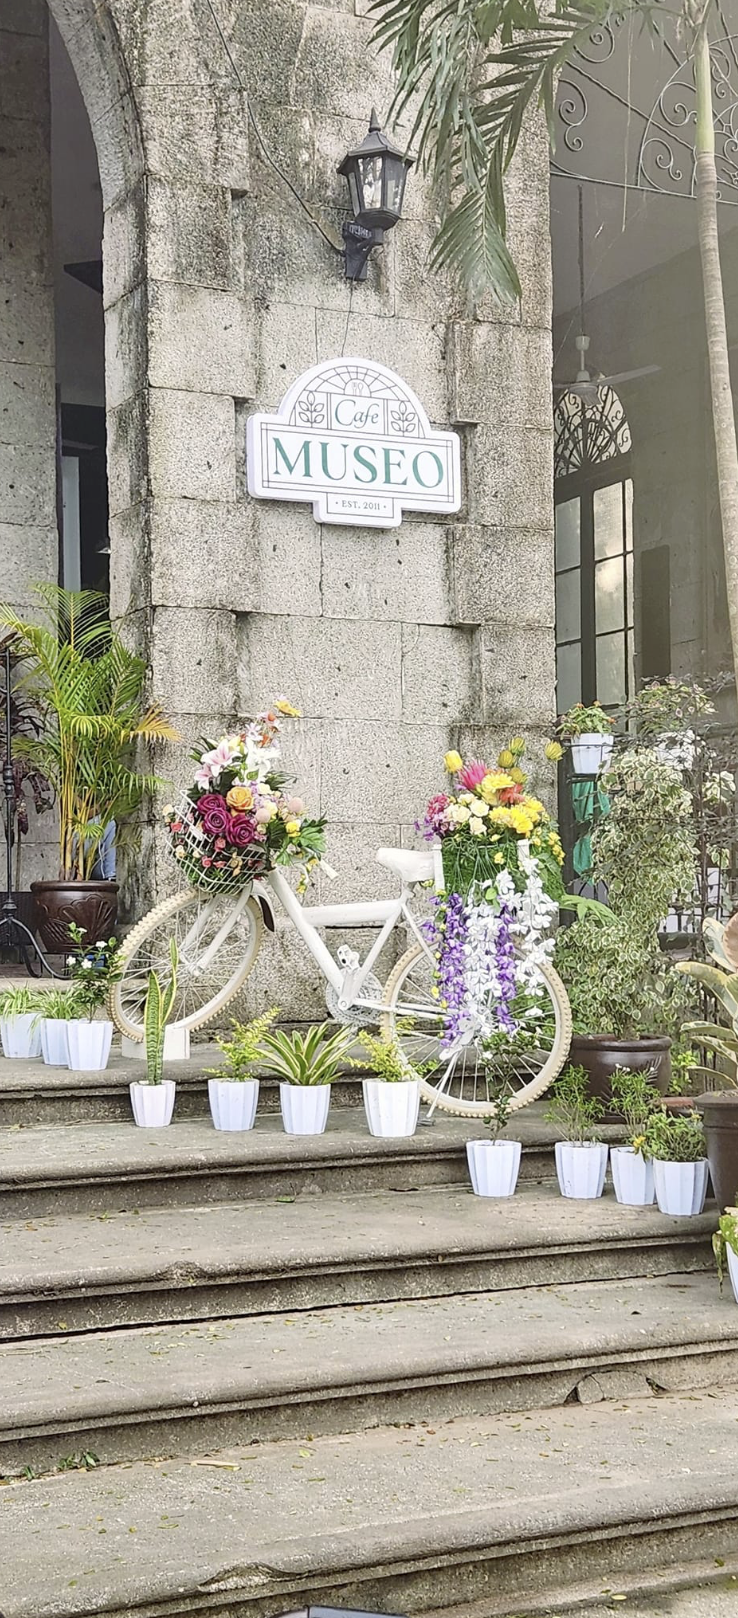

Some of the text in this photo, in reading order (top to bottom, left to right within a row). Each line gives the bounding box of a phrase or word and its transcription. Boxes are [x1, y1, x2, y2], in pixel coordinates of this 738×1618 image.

[335, 399, 380, 429] Cafe
[272, 437, 444, 488] MUSEO
[341, 500, 381, 511] EST. 2011
